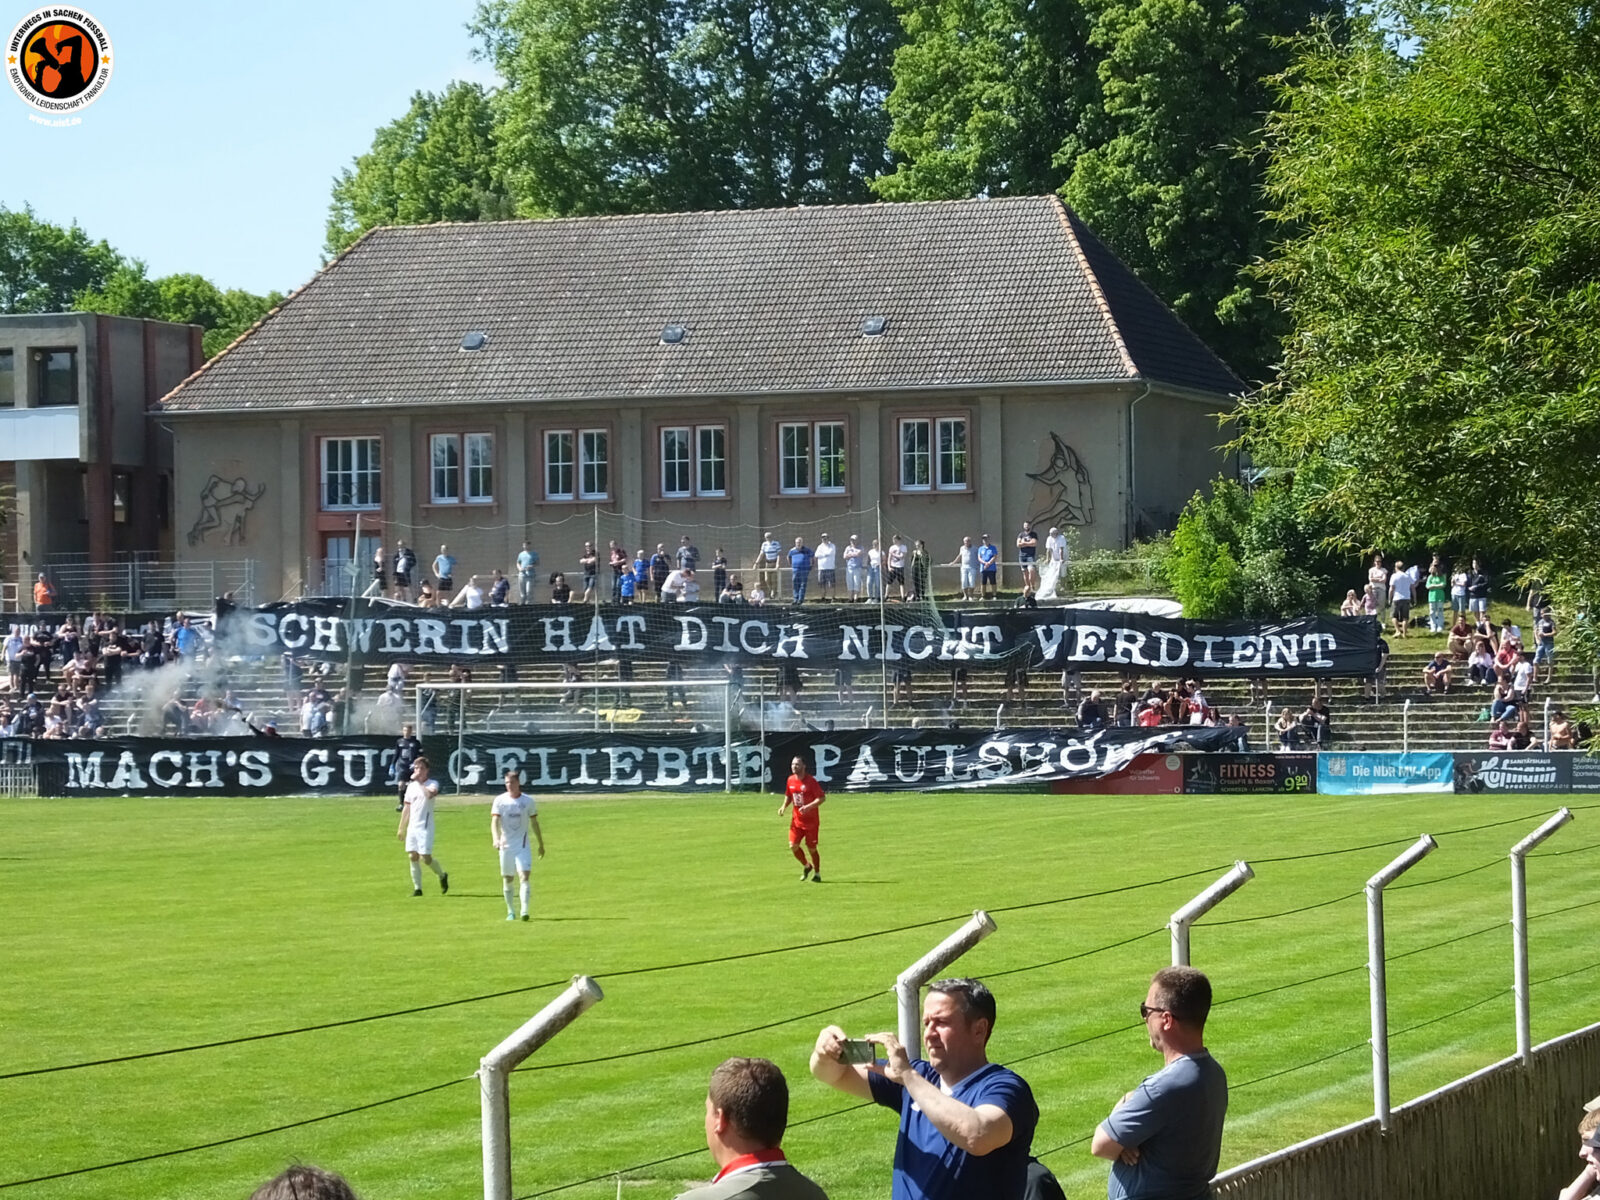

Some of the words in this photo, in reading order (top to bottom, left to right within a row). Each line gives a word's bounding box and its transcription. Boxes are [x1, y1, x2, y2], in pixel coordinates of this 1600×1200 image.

[245, 613, 509, 655] SCHWERIN
[540, 615, 646, 652] HAT
[673, 615, 809, 658] DICH
[838, 624, 1003, 660] NICHT
[1034, 624, 1337, 668] VERDIENT
[64, 750, 274, 789] MACH'S
[448, 746, 773, 787] GELIEBTE
[1220, 763, 1276, 777] FITNESS
[1352, 765, 1370, 777] Die
[1373, 765, 1396, 777] NDR
[1398, 765, 1441, 780] MV-App
